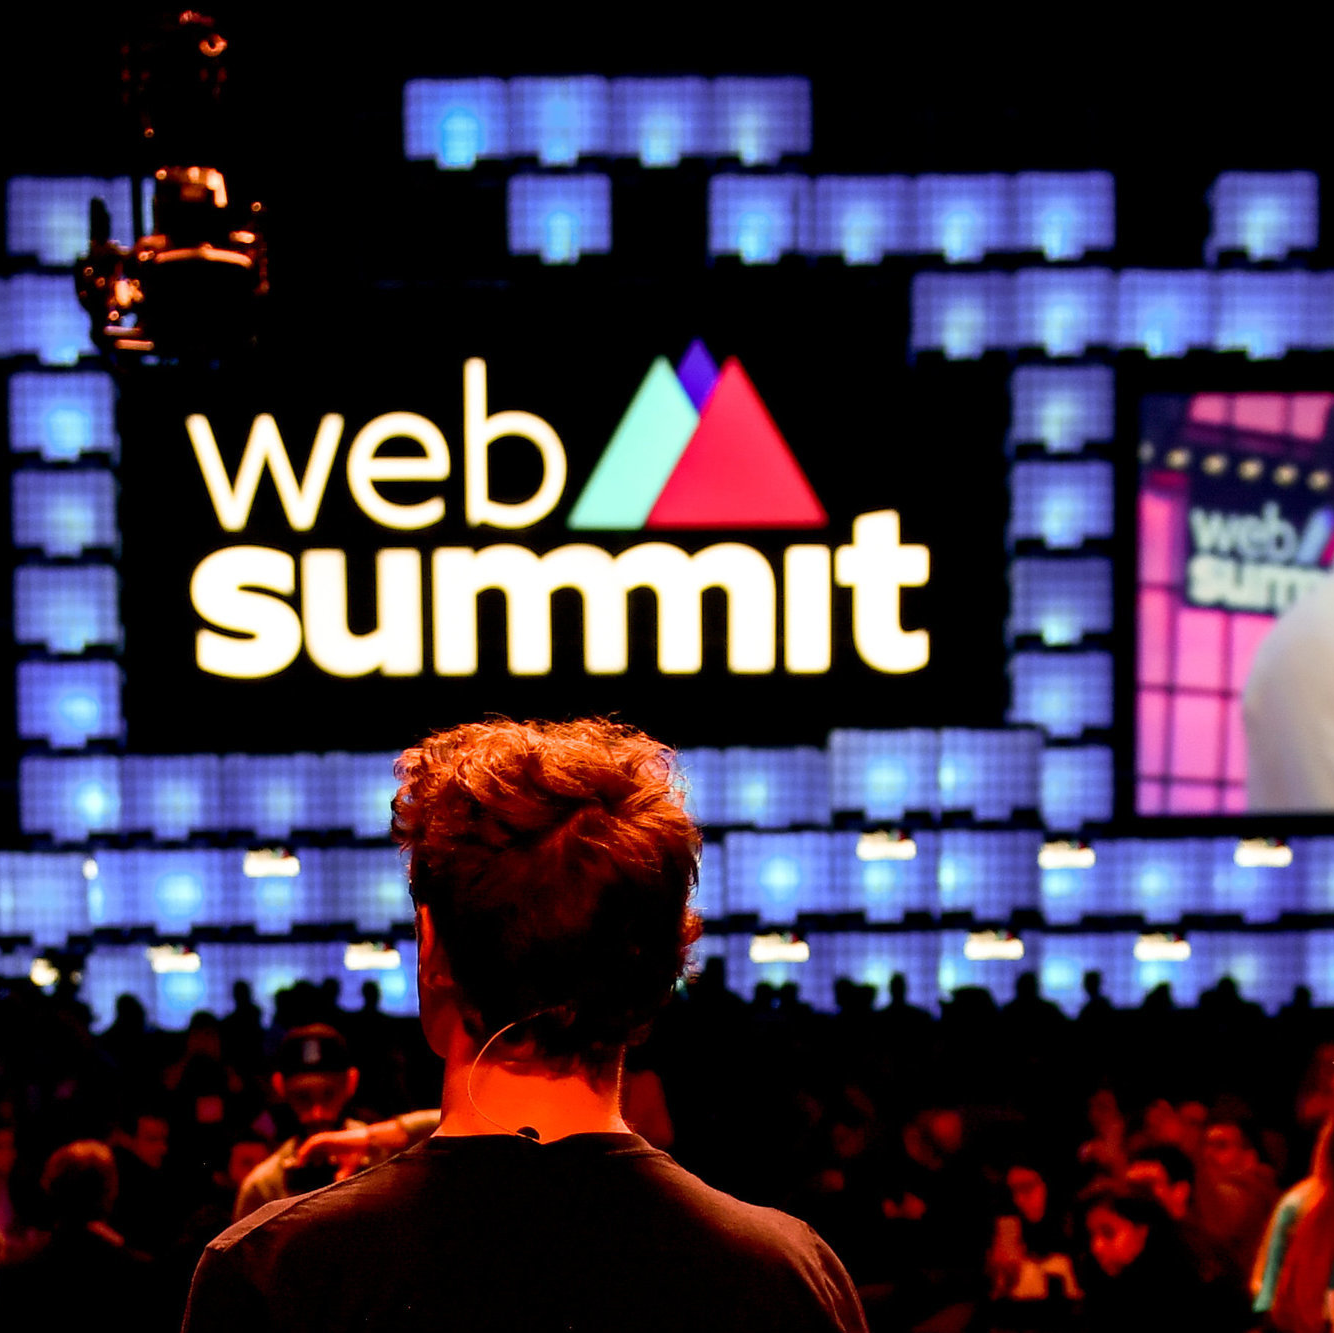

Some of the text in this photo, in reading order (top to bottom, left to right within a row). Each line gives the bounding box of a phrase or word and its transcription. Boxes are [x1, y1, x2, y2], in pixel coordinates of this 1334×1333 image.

[189, 359, 565, 529] web
[1189, 554, 1330, 612] sum
[1190, 500, 1297, 562] web
[192, 511, 928, 676] summit
